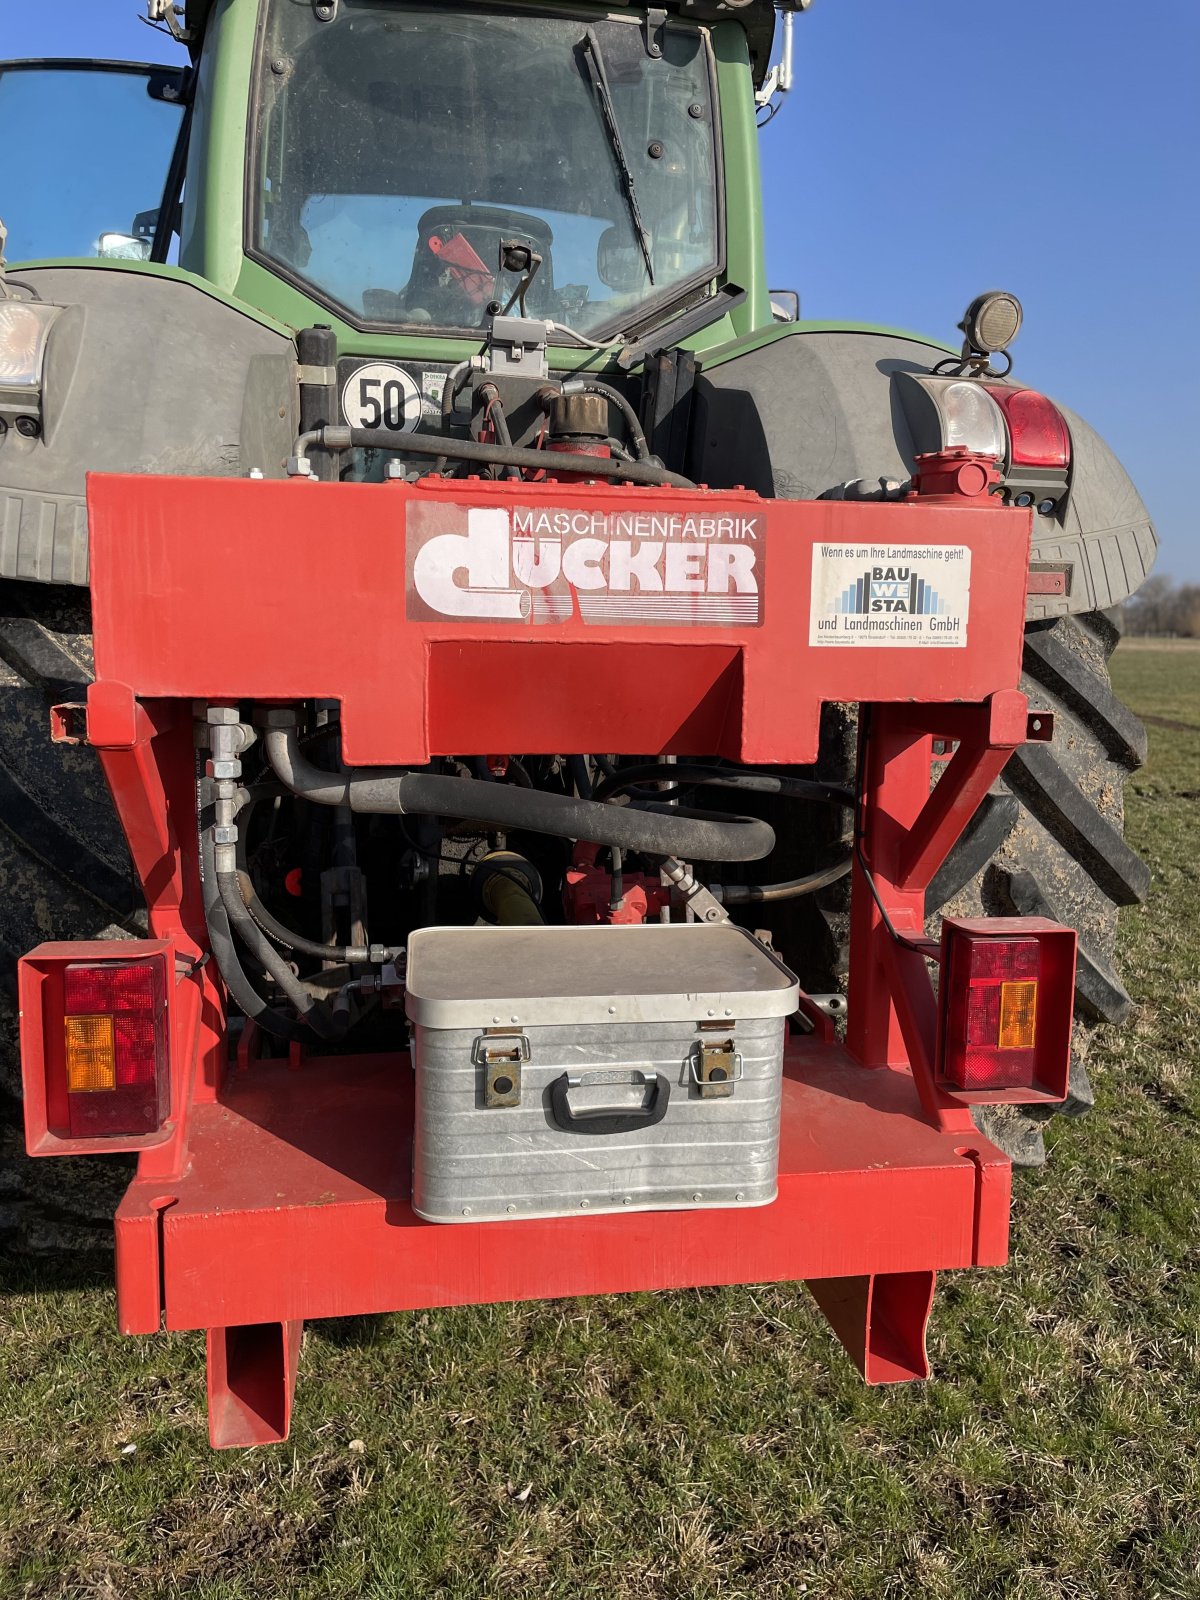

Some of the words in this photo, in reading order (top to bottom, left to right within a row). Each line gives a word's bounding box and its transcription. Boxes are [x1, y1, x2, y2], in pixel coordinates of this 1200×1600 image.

[360, 378, 405, 431] 50
[513, 512, 757, 539] MASCHINENFABRIK
[821, 546, 843, 558] Wenn
[845, 549, 854, 558] es
[857, 549, 868, 558] um
[870, 547, 885, 559] Ihre
[887, 547, 942, 559] Landmaschine
[944, 549, 963, 562] geht!
[872, 567, 909, 581] BAU
[872, 583, 909, 597] WE
[871, 599, 908, 612] STA
[818, 615, 837, 630] und
[845, 615, 922, 631] Landmaschinen
[929, 616, 960, 631] GmbH
